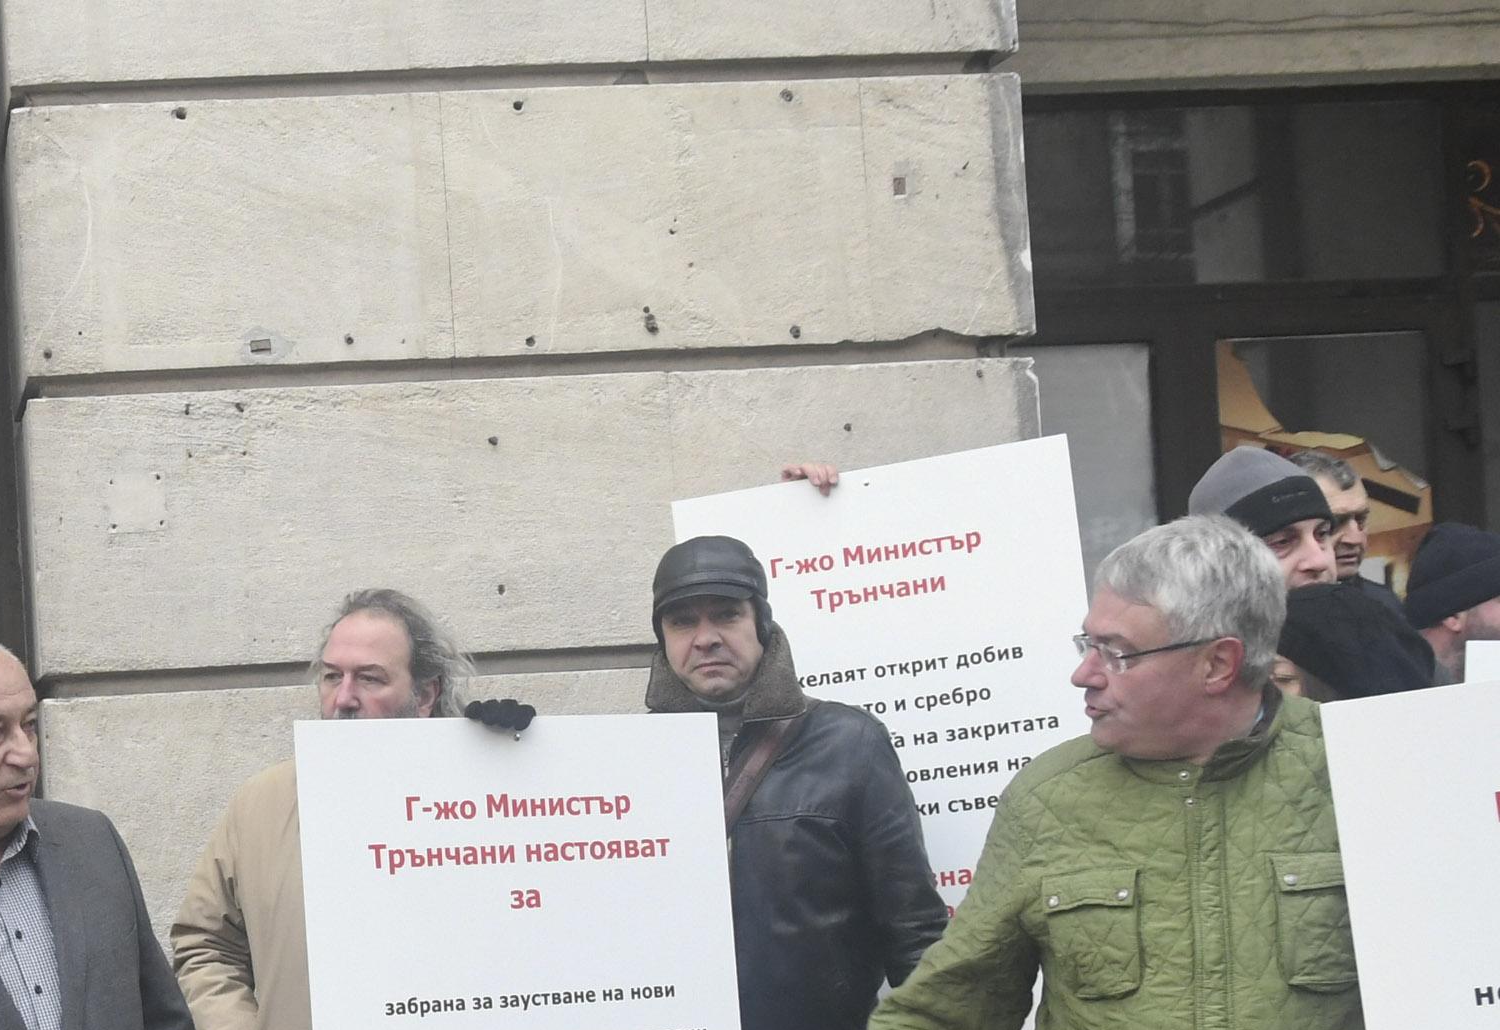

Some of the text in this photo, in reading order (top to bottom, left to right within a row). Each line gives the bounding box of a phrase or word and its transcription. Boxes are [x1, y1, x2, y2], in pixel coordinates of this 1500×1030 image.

[769, 530, 982, 579] Г-жо Министър
[809, 575, 946, 614] Трънчани
[873, 656, 949, 679] открит
[955, 645, 1024, 671] добив
[893, 698, 907, 713] и
[913, 686, 992, 713] сребро
[912, 730, 939, 747] на
[945, 715, 1060, 743] закритата
[405, 792, 632, 822] Г-жо Министър
[367, 837, 671, 876] Трънчани настояват
[509, 888, 542, 910] за
[384, 984, 676, 1019] забрана за заустване на нови
